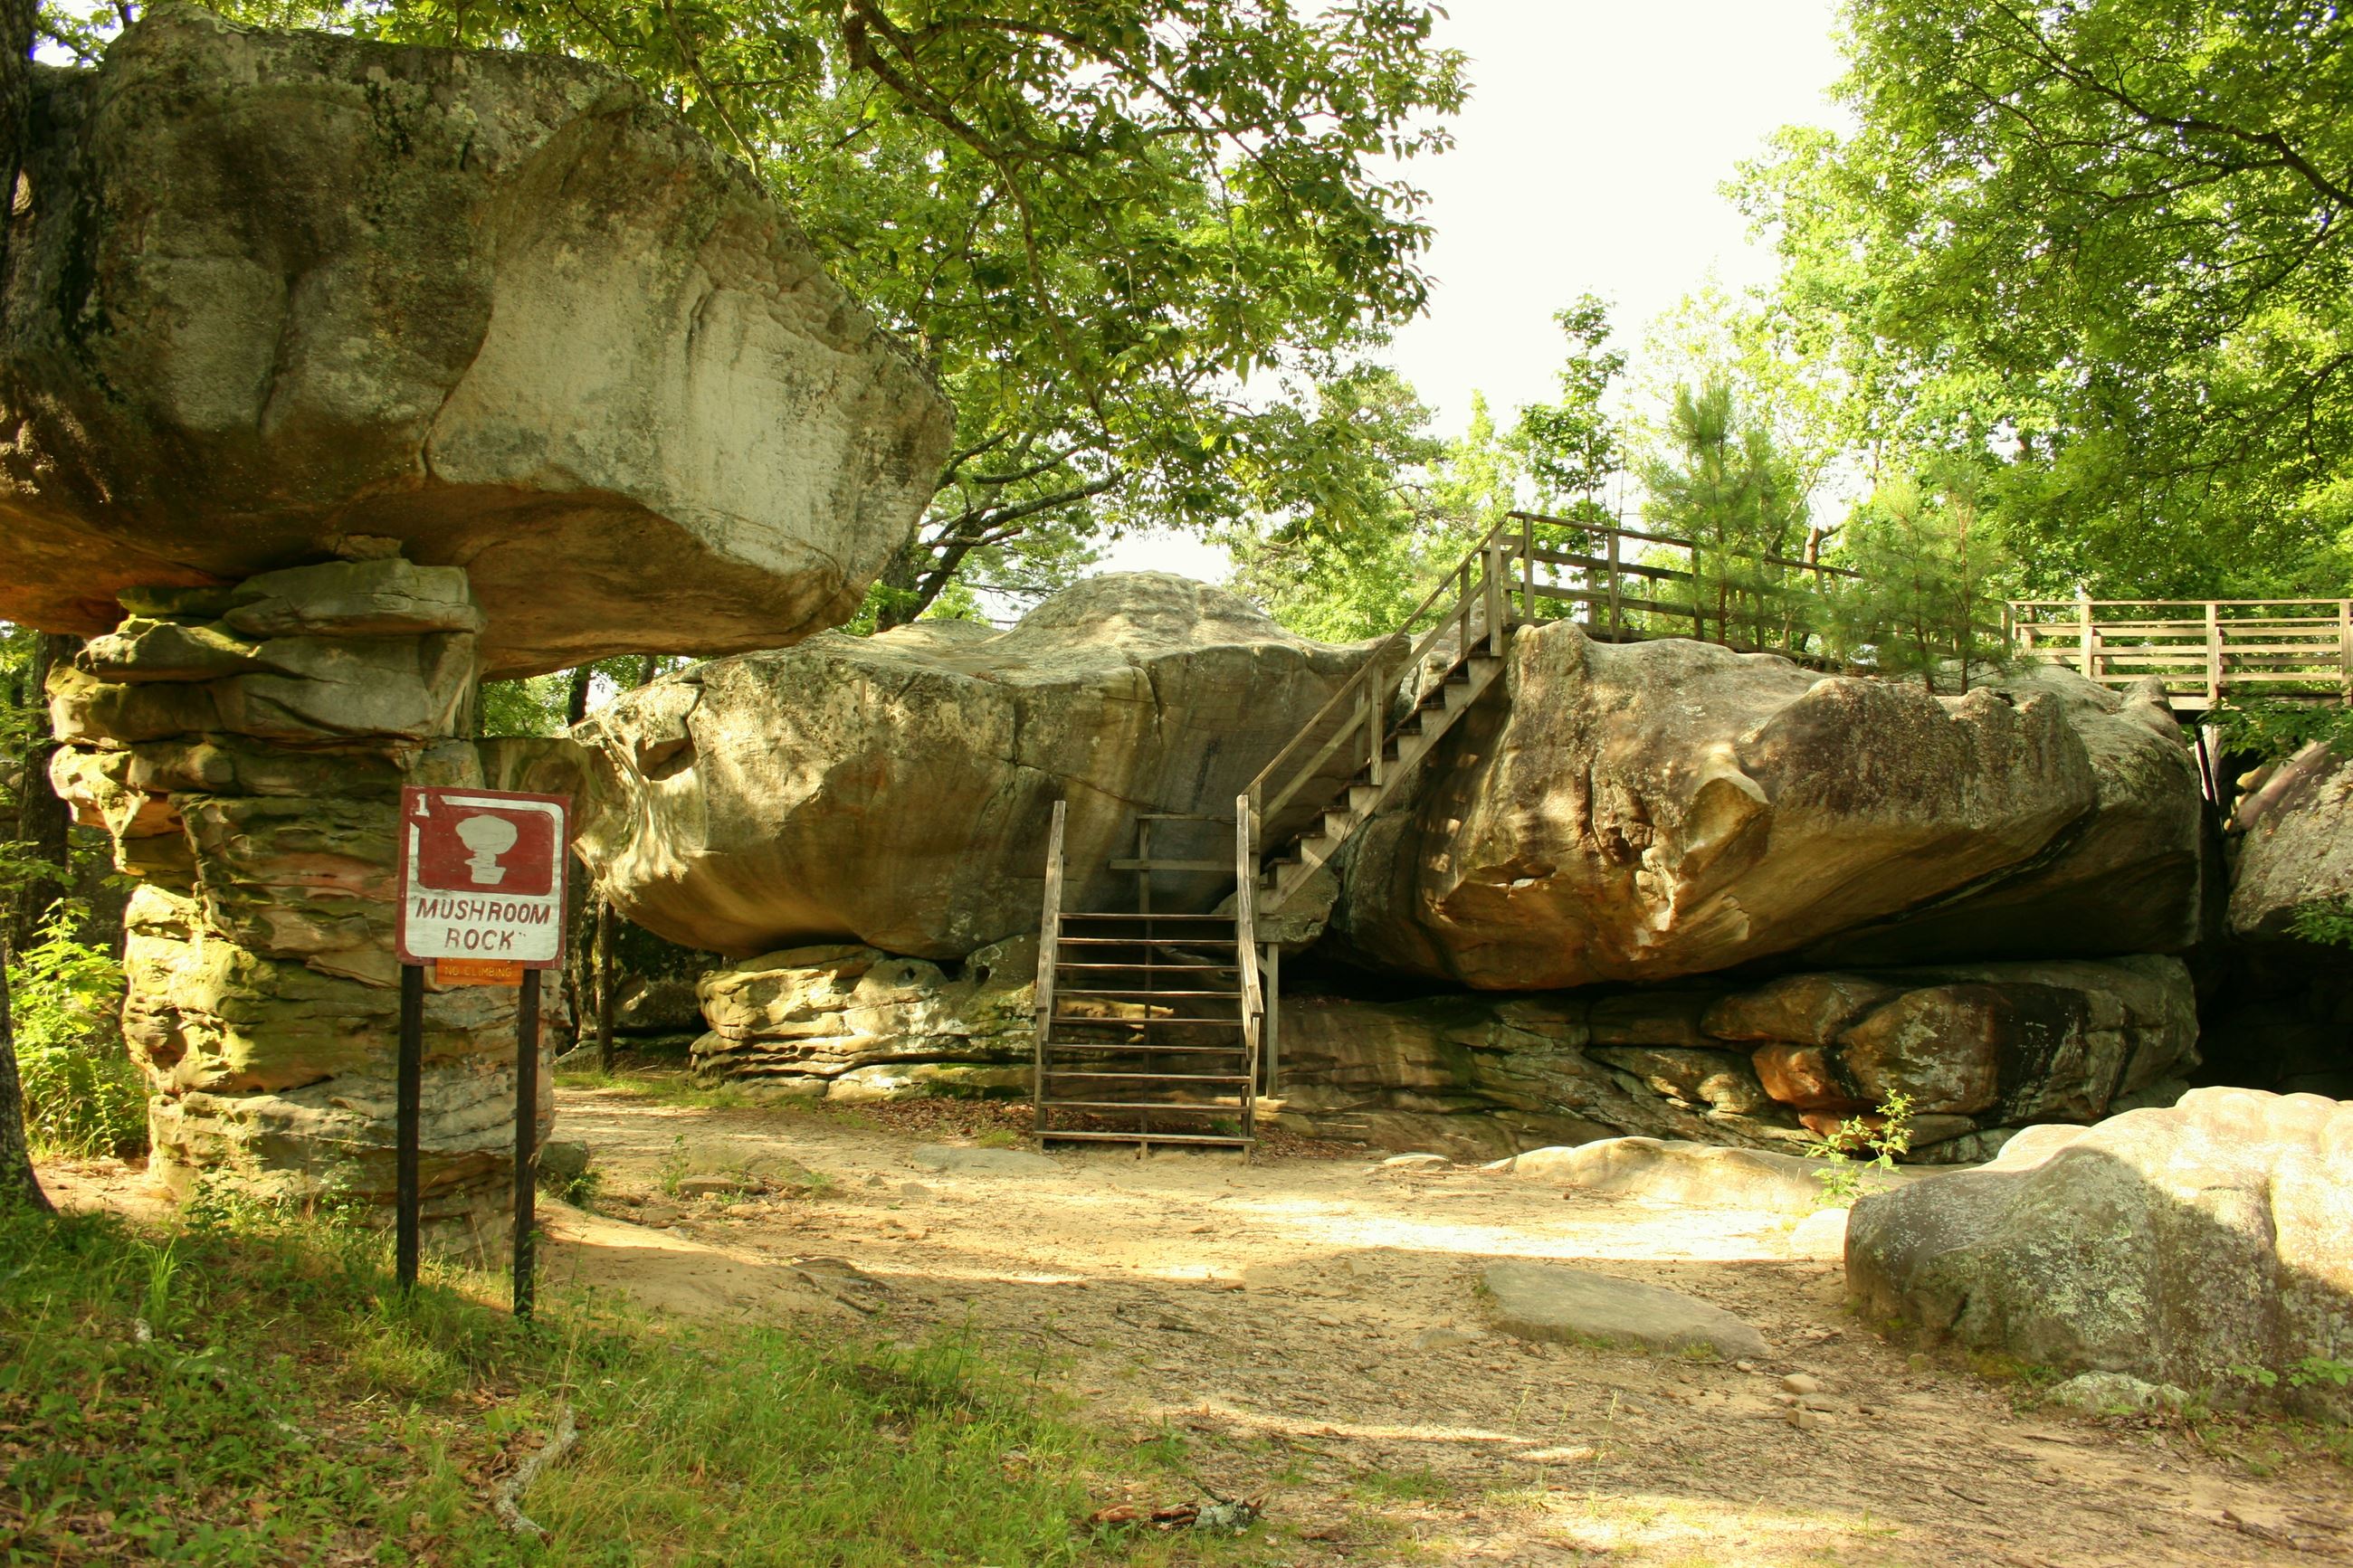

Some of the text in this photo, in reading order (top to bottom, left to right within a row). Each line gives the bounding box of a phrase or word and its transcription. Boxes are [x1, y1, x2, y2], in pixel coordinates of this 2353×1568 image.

[414, 794, 430, 818] 1
[444, 965, 513, 978] NO CLIMBING
